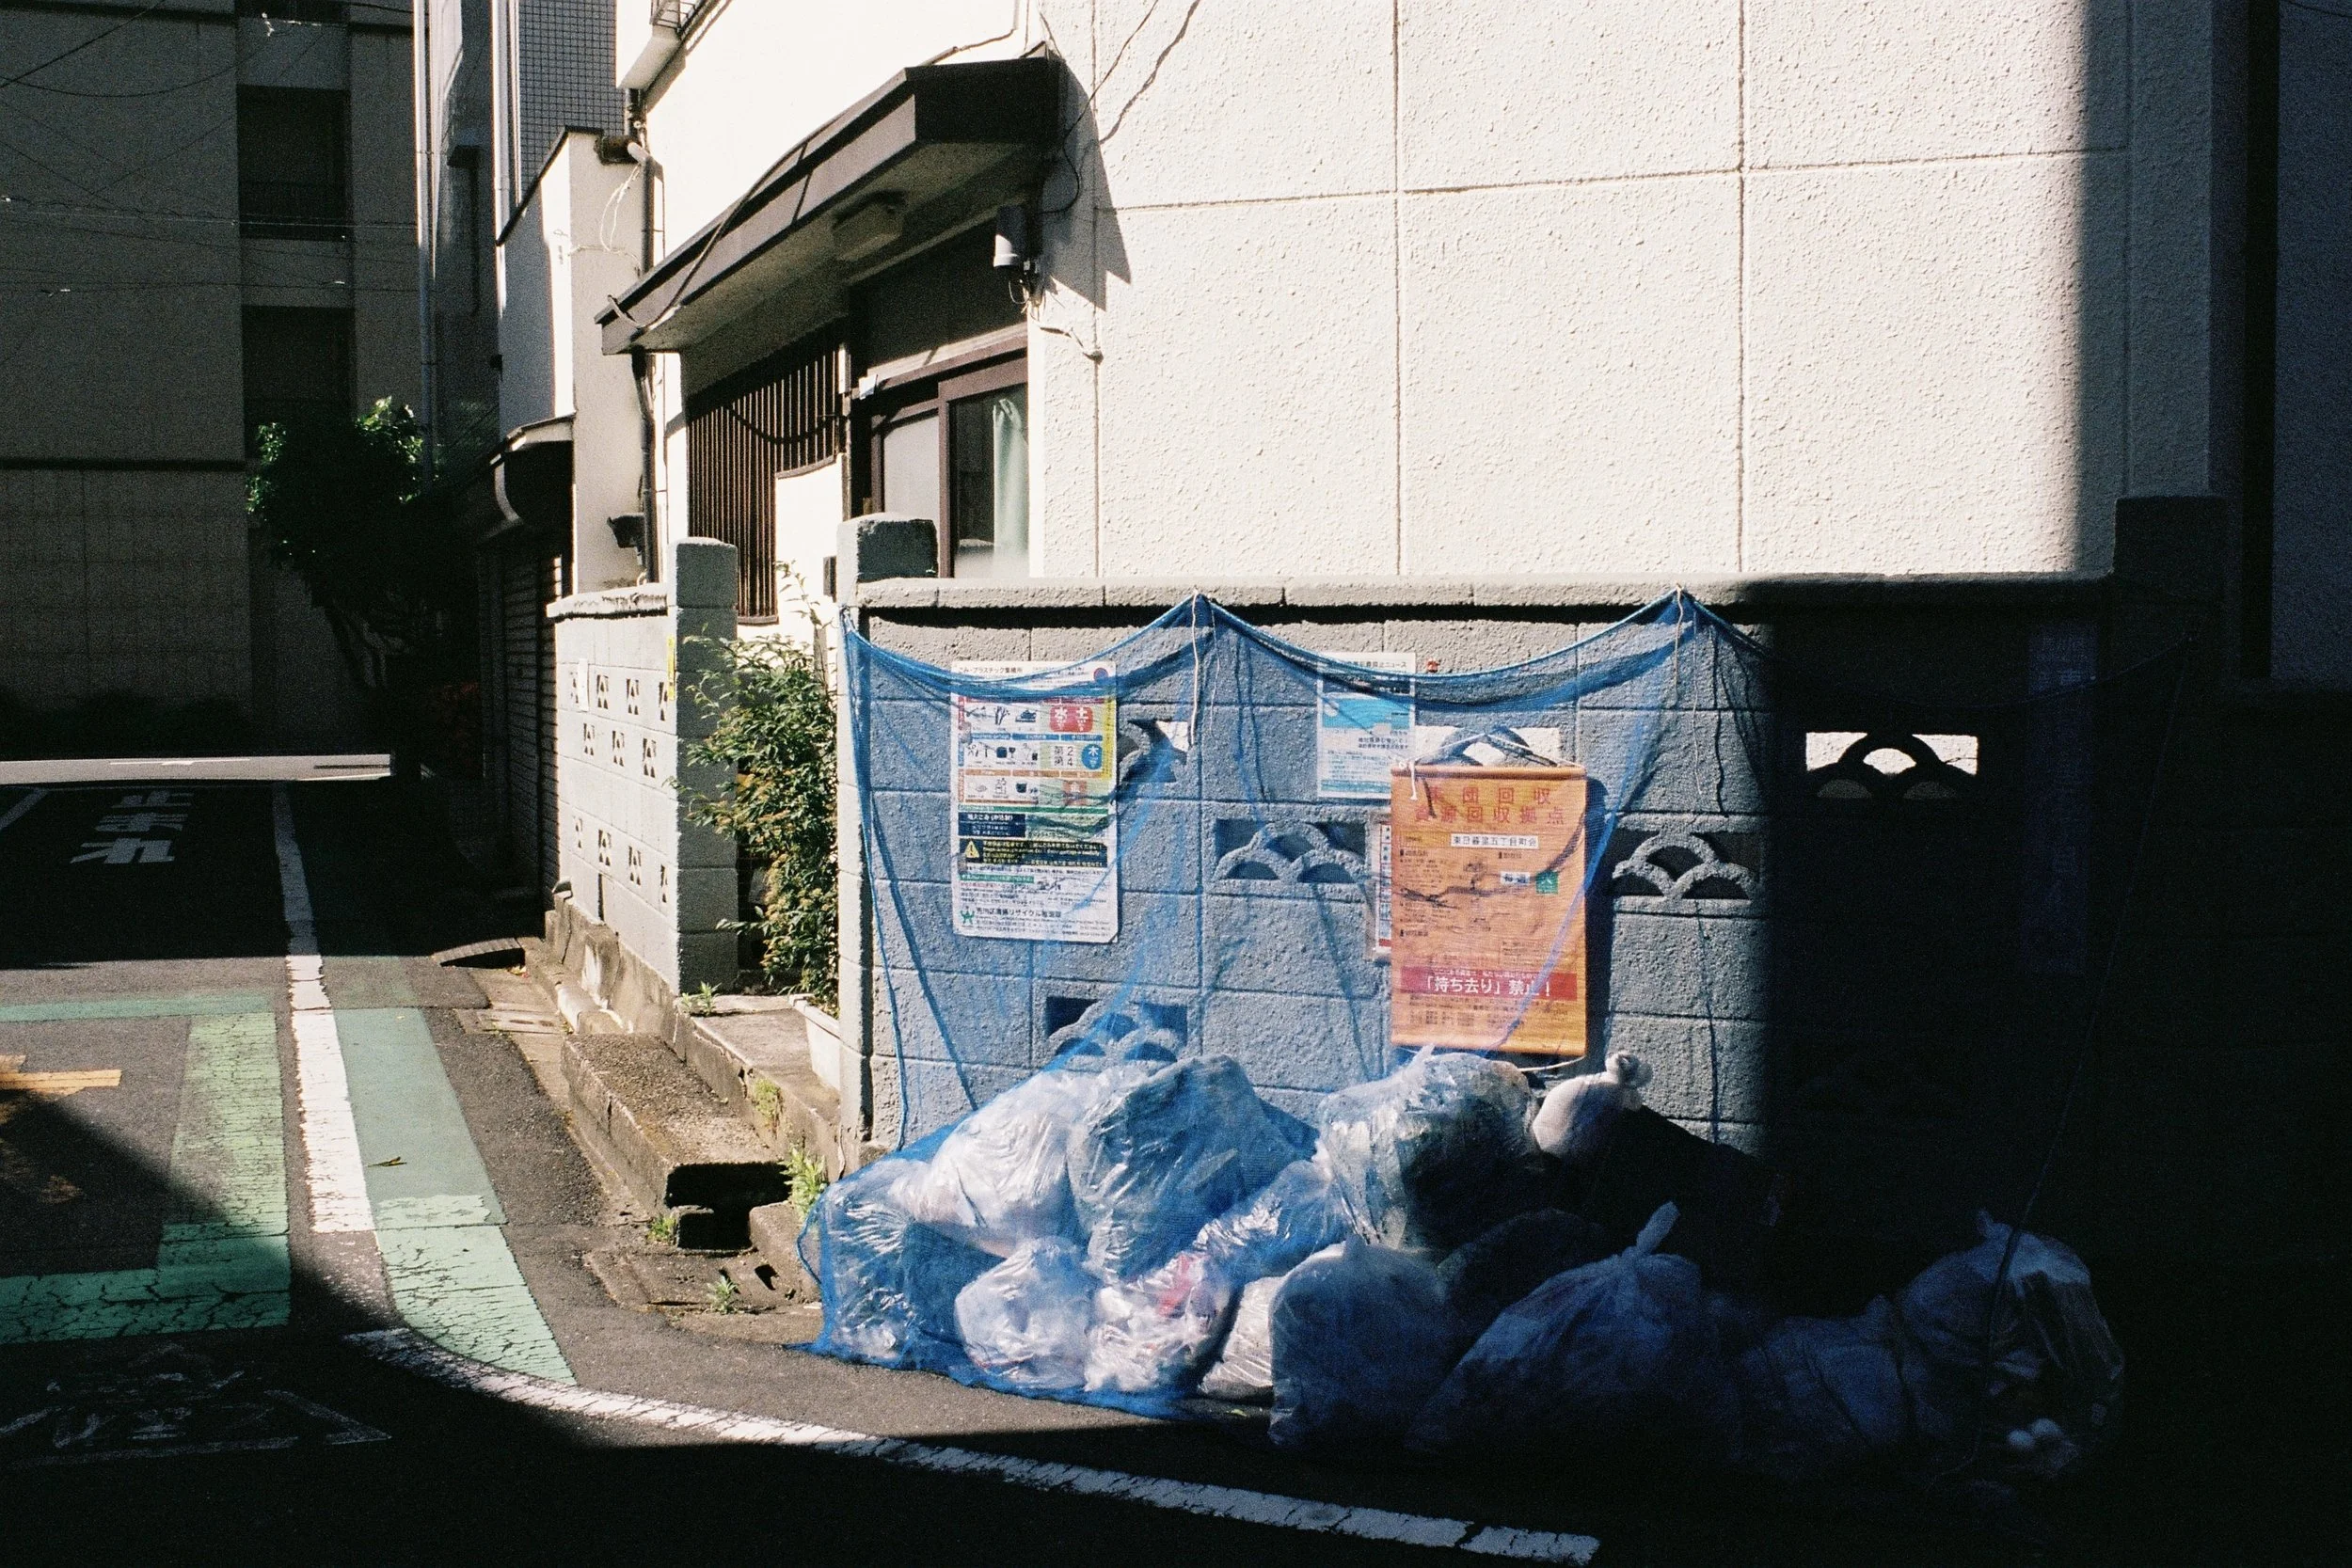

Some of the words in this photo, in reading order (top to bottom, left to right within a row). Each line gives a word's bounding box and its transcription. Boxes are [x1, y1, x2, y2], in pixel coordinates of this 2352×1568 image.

[1429, 786, 1550, 805] 集団回収
[1415, 805, 1565, 825] 資源回収拠点
[70, 789, 195, 864] 止まれ
[1453, 835, 1537, 847] 東日暮里五丁目町会
